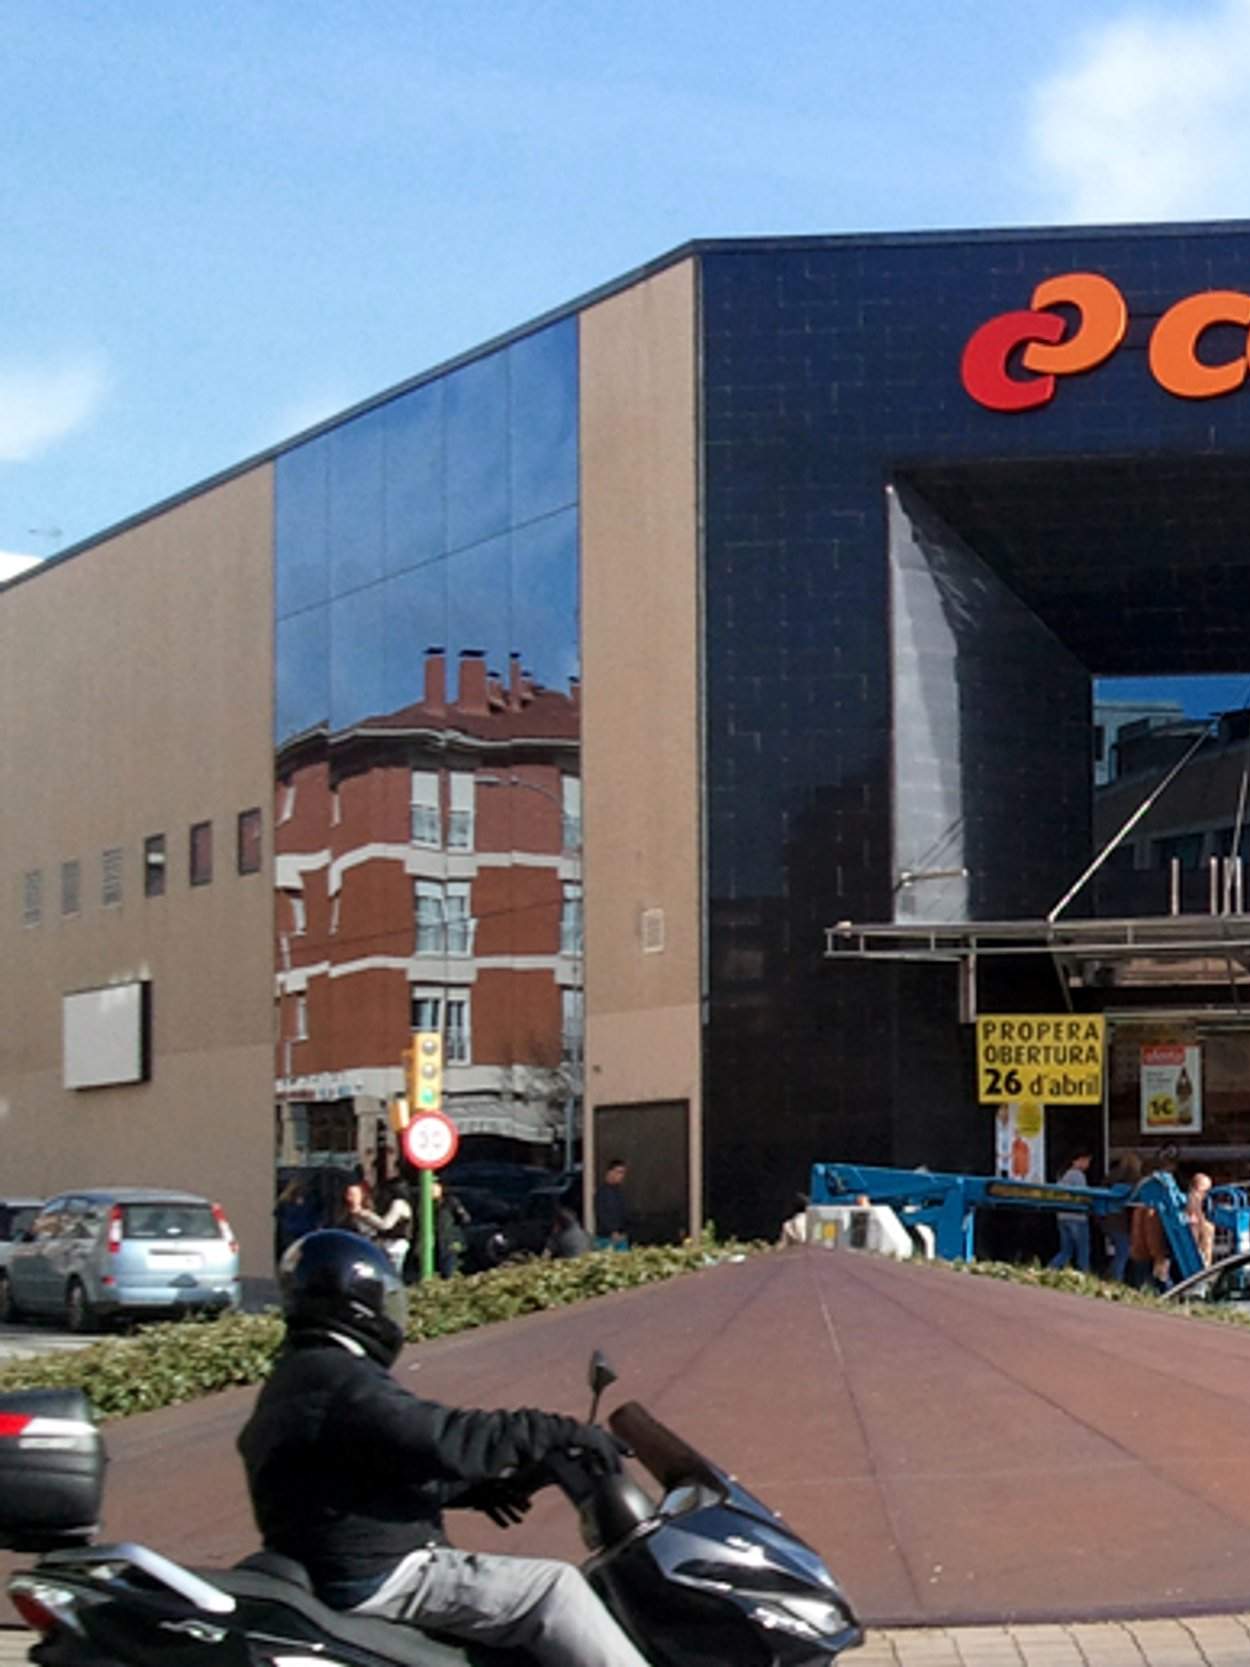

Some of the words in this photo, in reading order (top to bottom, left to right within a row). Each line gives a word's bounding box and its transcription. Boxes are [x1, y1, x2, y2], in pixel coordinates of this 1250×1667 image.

[982, 1021, 1099, 1041] PROPERA
[984, 1045, 1099, 1066] OBERTURA
[985, 1069, 1022, 1096] 26
